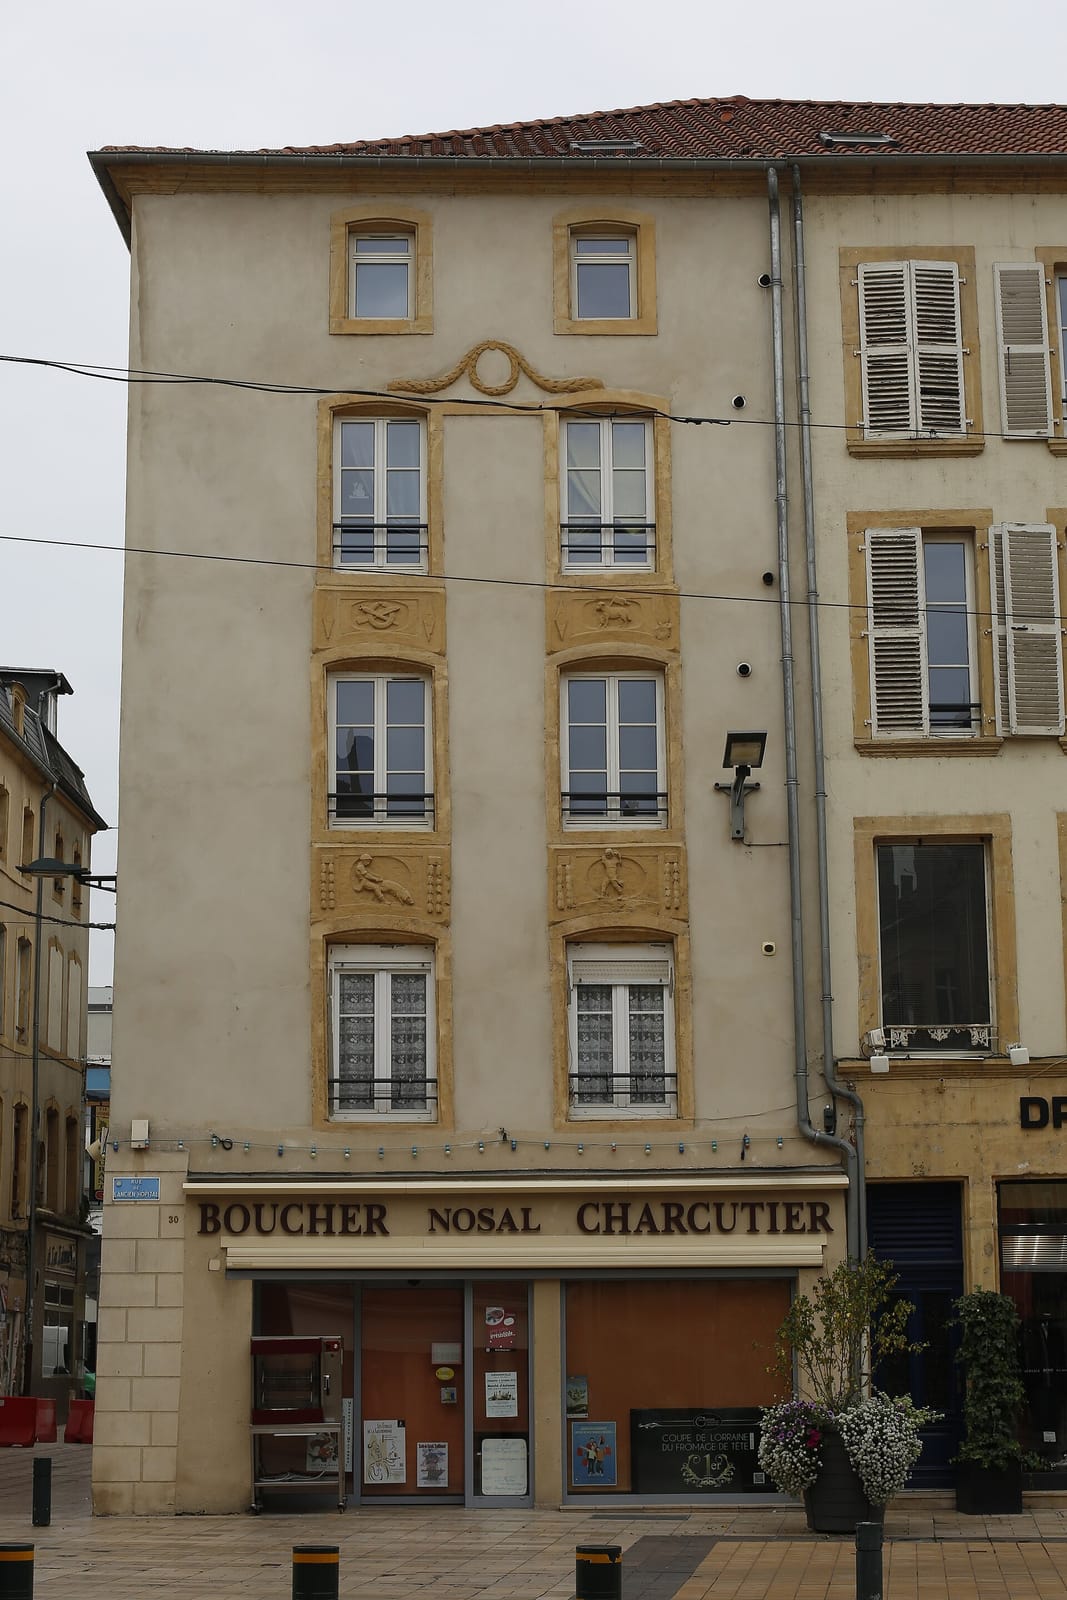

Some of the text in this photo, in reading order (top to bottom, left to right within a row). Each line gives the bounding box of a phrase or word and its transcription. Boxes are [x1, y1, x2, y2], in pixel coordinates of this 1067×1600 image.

[168, 1215, 179, 1224] 30
[197, 1201, 834, 1235] BOUCHER NOSAL CHARCUTIER
[662, 1433, 692, 1442] COUPE
[696, 1433, 706, 1442] DE
[710, 1432, 749, 1442] LORRAINE
[662, 1443, 673, 1452] DU
[675, 1443, 716, 1452] FROMAGE
[718, 1442, 729, 1450] DE
